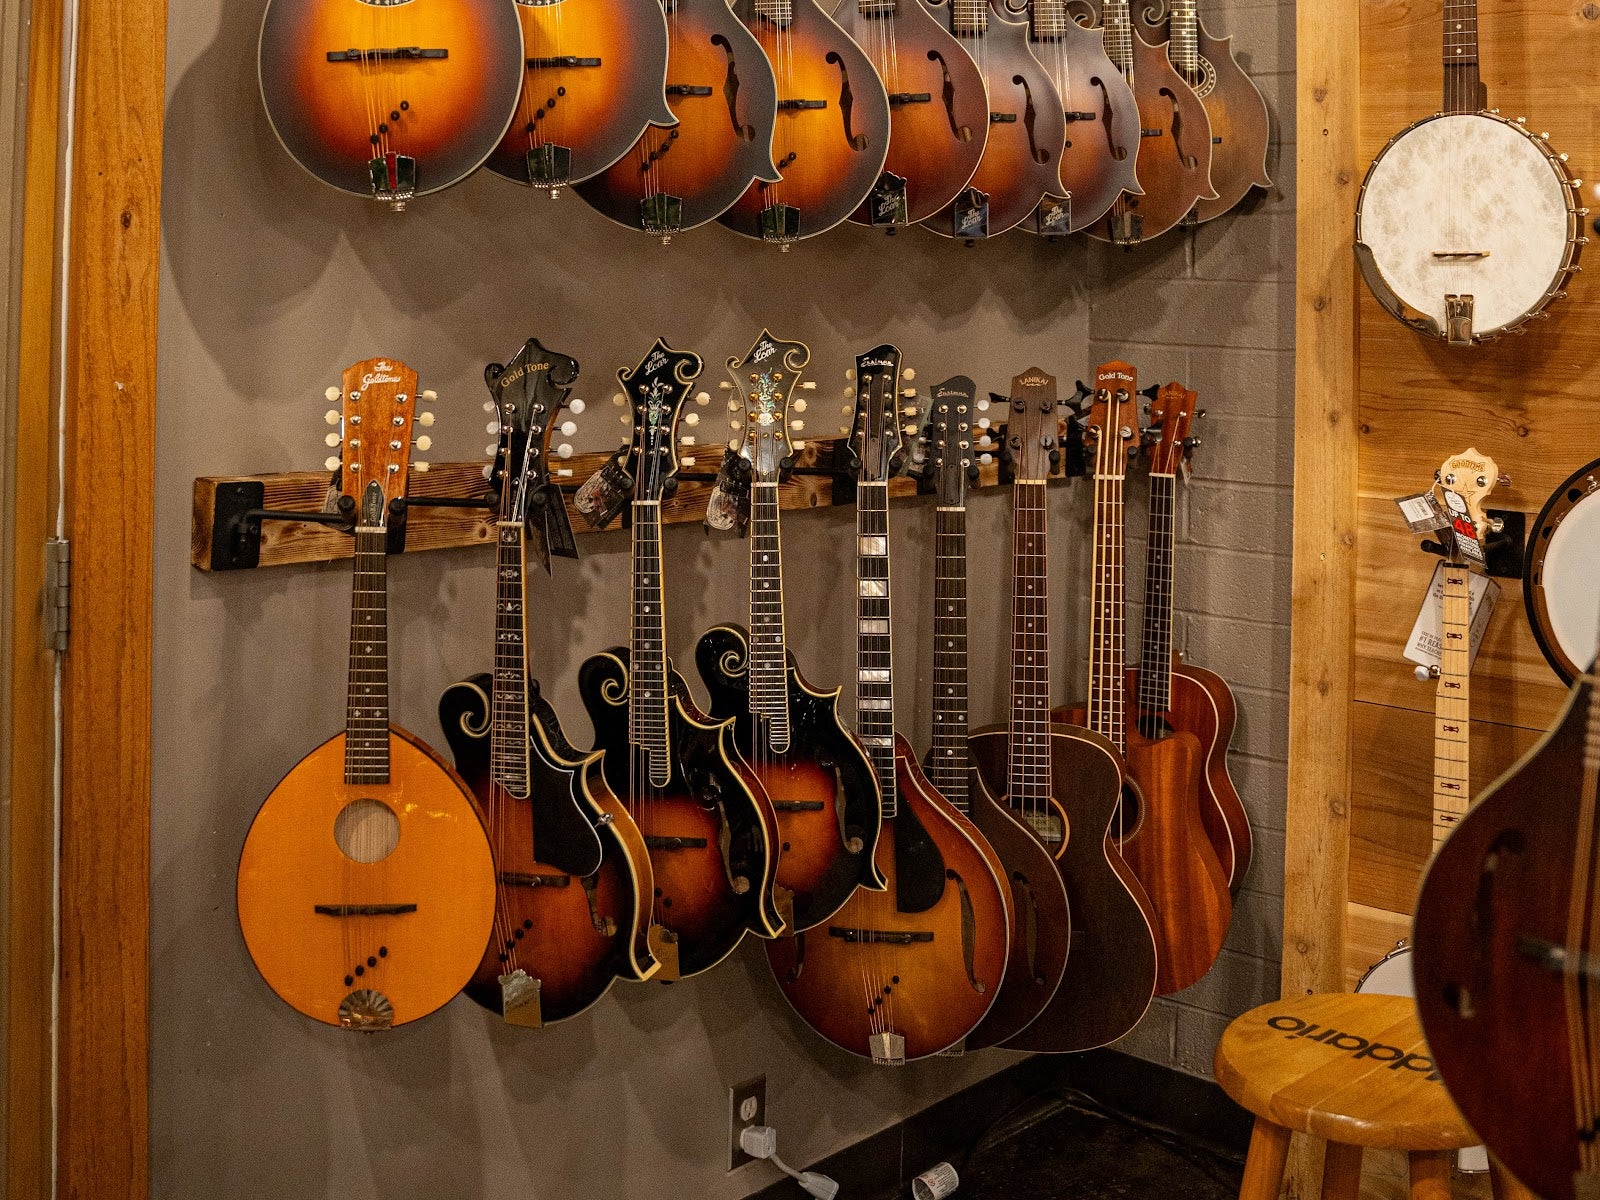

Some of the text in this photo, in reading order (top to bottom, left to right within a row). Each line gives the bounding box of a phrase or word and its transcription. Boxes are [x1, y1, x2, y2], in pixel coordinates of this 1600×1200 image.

[878, 202, 900, 216] Loar
[968, 208, 980, 219] The
[961, 216, 983, 230] Loar
[758, 340, 773, 351] The
[650, 350, 665, 362] The
[753, 348, 778, 364] Loar
[860, 356, 894, 368] Eastman
[374, 361, 394, 372] The
[645, 356, 670, 376] Loar
[500, 361, 550, 388] Gold Tone
[1098, 372, 1134, 382] Gold Tone
[1020, 376, 1048, 386] LANIKAI
[937, 388, 968, 398] Eastman
[1448, 508, 1472, 523] UP TO
[1454, 518, 1476, 540] 48
